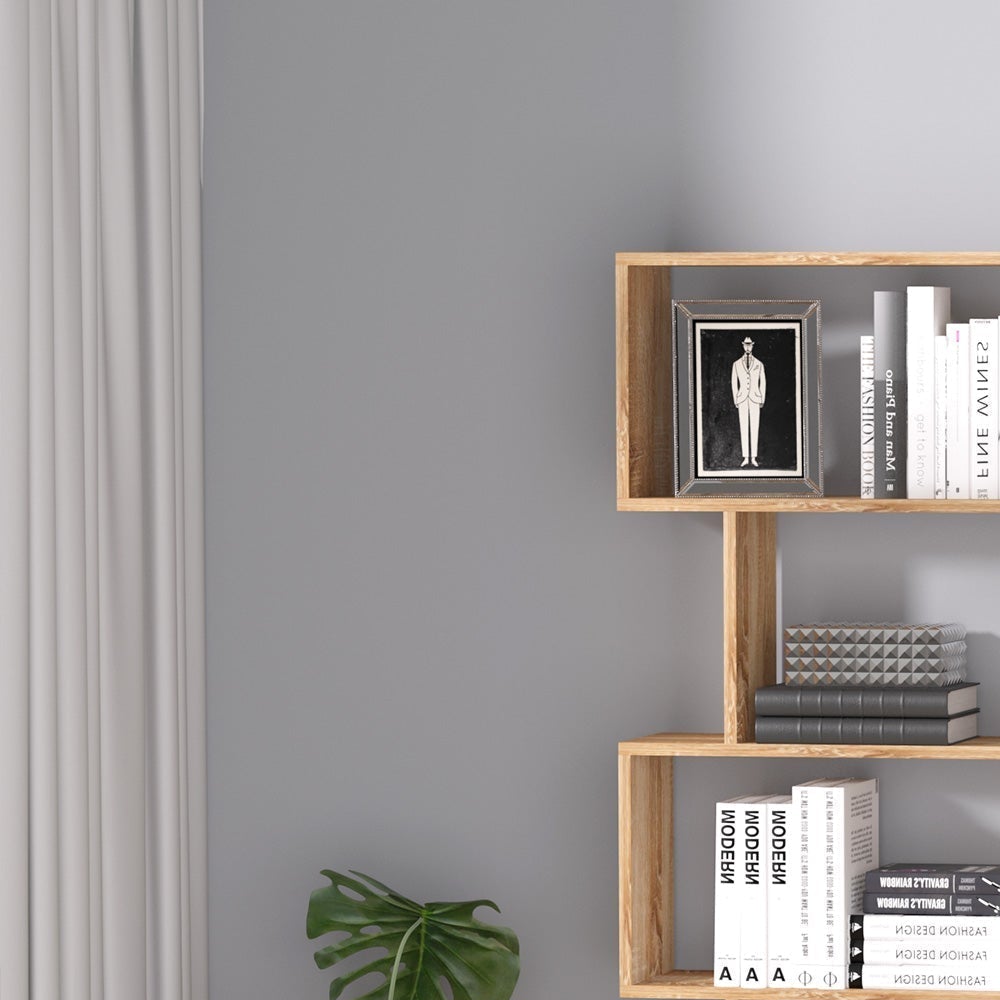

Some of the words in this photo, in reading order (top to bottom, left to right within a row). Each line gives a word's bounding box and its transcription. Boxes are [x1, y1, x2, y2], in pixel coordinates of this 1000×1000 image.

[861, 377, 874, 444] FASHION
[719, 966, 732, 981] A
[746, 968, 759, 982] A
[772, 968, 786, 982] A
